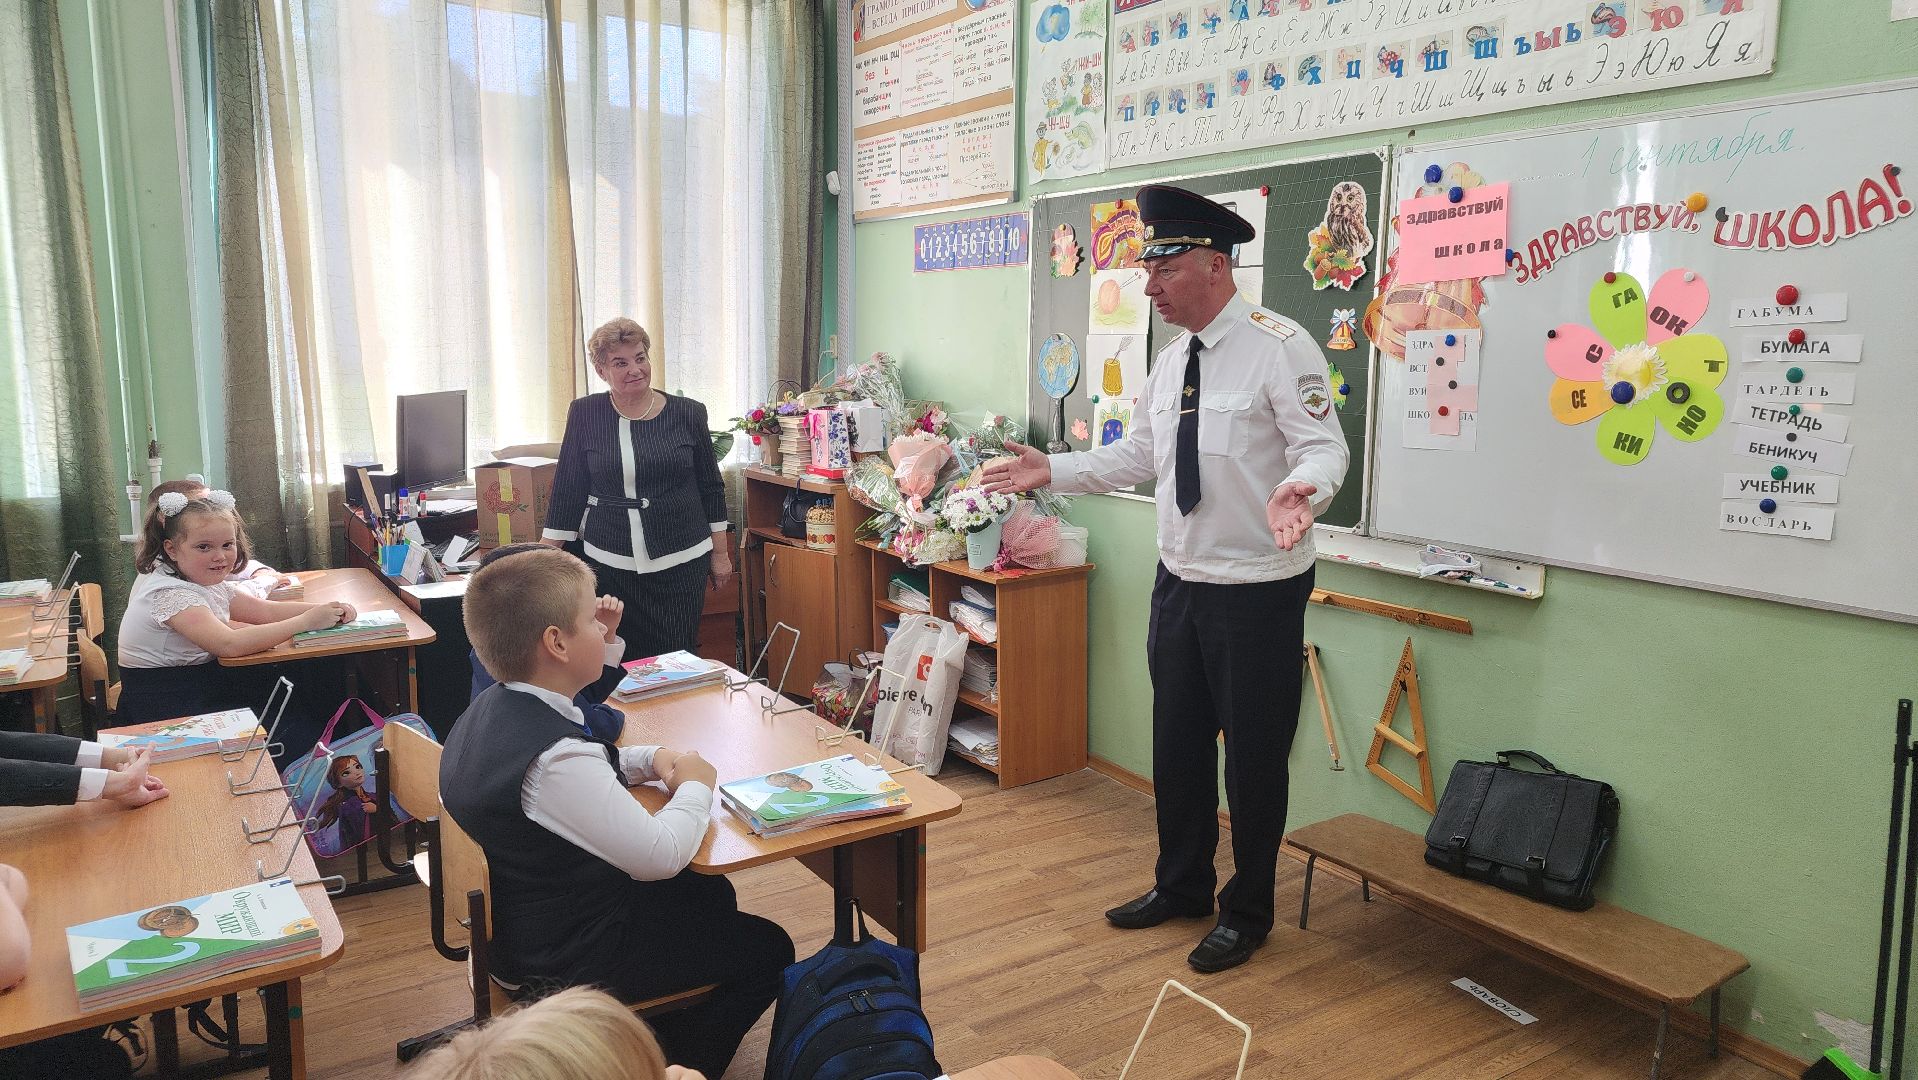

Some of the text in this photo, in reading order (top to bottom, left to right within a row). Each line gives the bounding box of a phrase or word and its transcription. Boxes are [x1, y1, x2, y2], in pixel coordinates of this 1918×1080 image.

[864, 71, 876, 81] без
[1406, 196, 1504, 226] здравствуй
[920, 227, 1020, 259] 0 1 2 3 4 5 6 7 8 9 10
[1612, 288, 1639, 309] ГА
[1649, 306, 1689, 336] ОК
[1737, 305, 1815, 319] ГАБУМА
[1760, 340, 1831, 354] БУМАГА
[1571, 388, 1588, 409] СЕ
[1744, 384, 1830, 397] ТАРДЕТЬ
[1675, 404, 1707, 436] НО
[1750, 405, 1823, 432] ТЕТРАДЬ
[1612, 431, 1645, 457] КИ
[1748, 442, 1818, 464] БЕНИКУЧ
[1739, 478, 1816, 495] УЧЕБНИК
[1726, 514, 1813, 531] ВОСЛАРЬ
[1469, 985, 1522, 1018] СЛОВАРЬ
